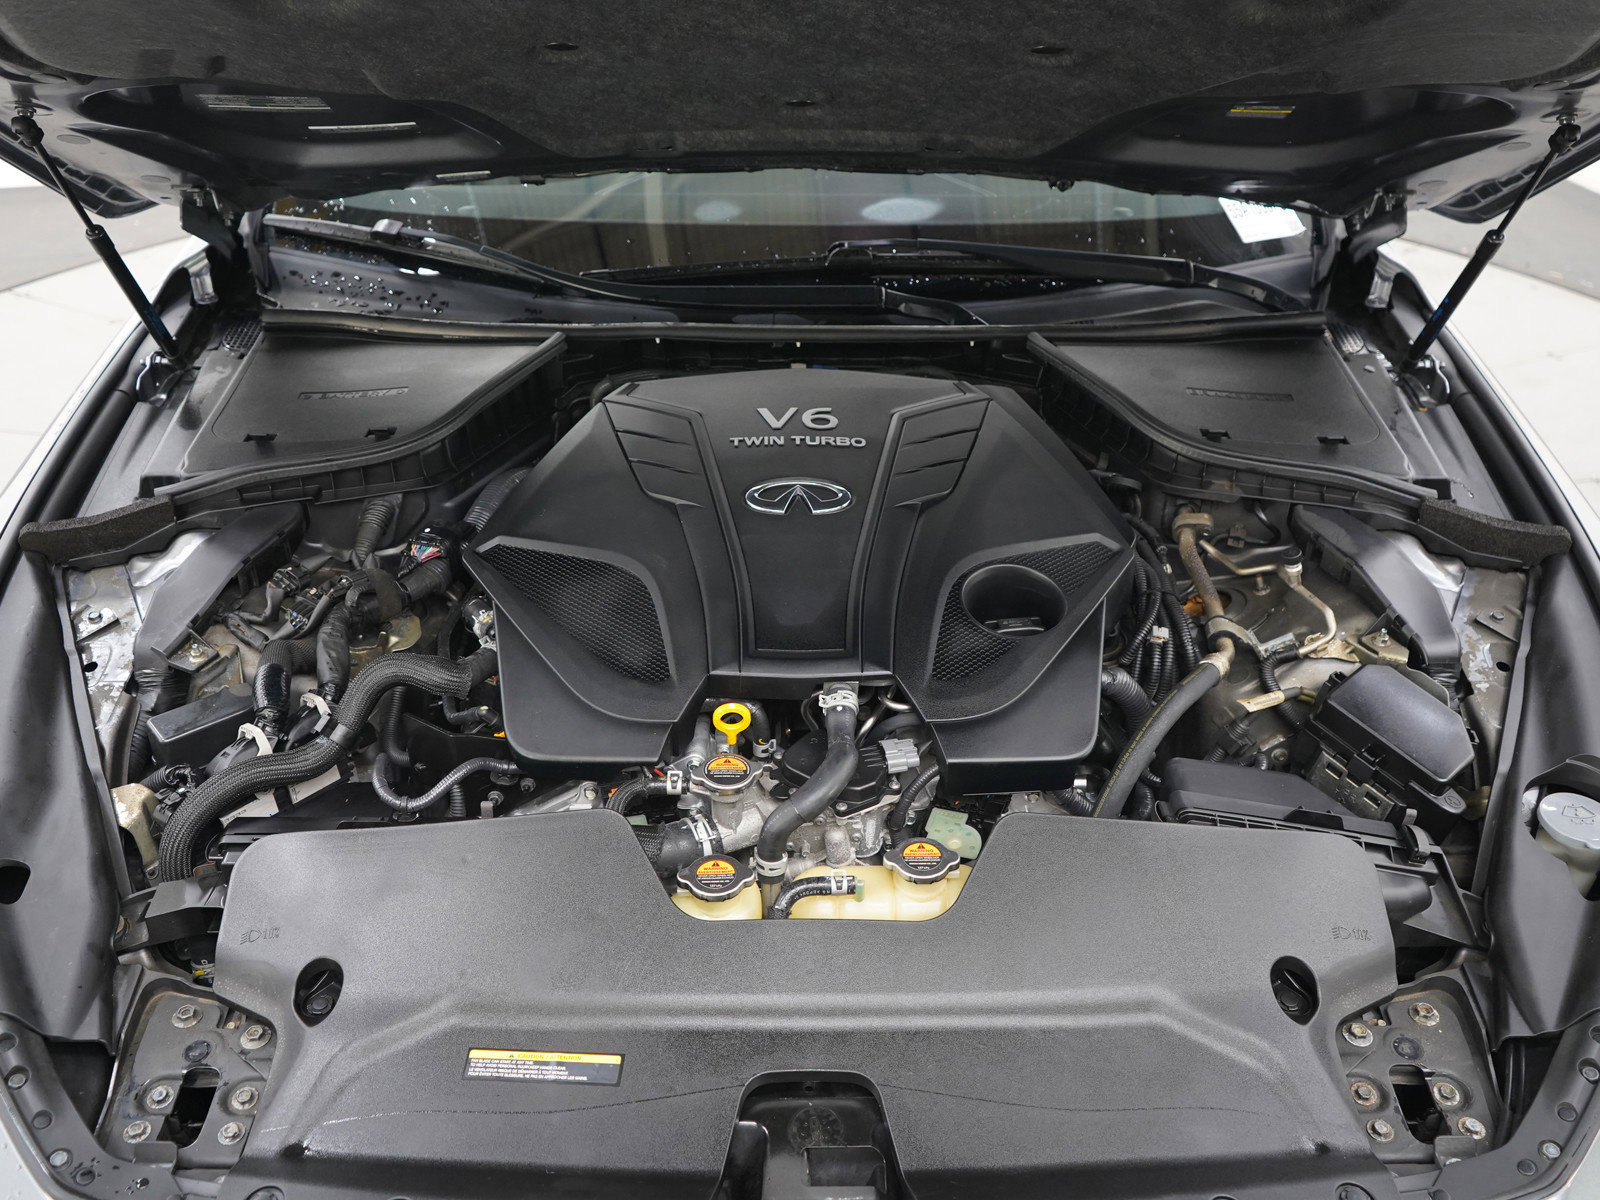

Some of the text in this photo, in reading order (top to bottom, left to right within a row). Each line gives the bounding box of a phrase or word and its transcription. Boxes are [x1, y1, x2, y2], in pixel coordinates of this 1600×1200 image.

[757, 407, 839, 430] V6
[730, 436, 867, 447] TWIN TURBO
